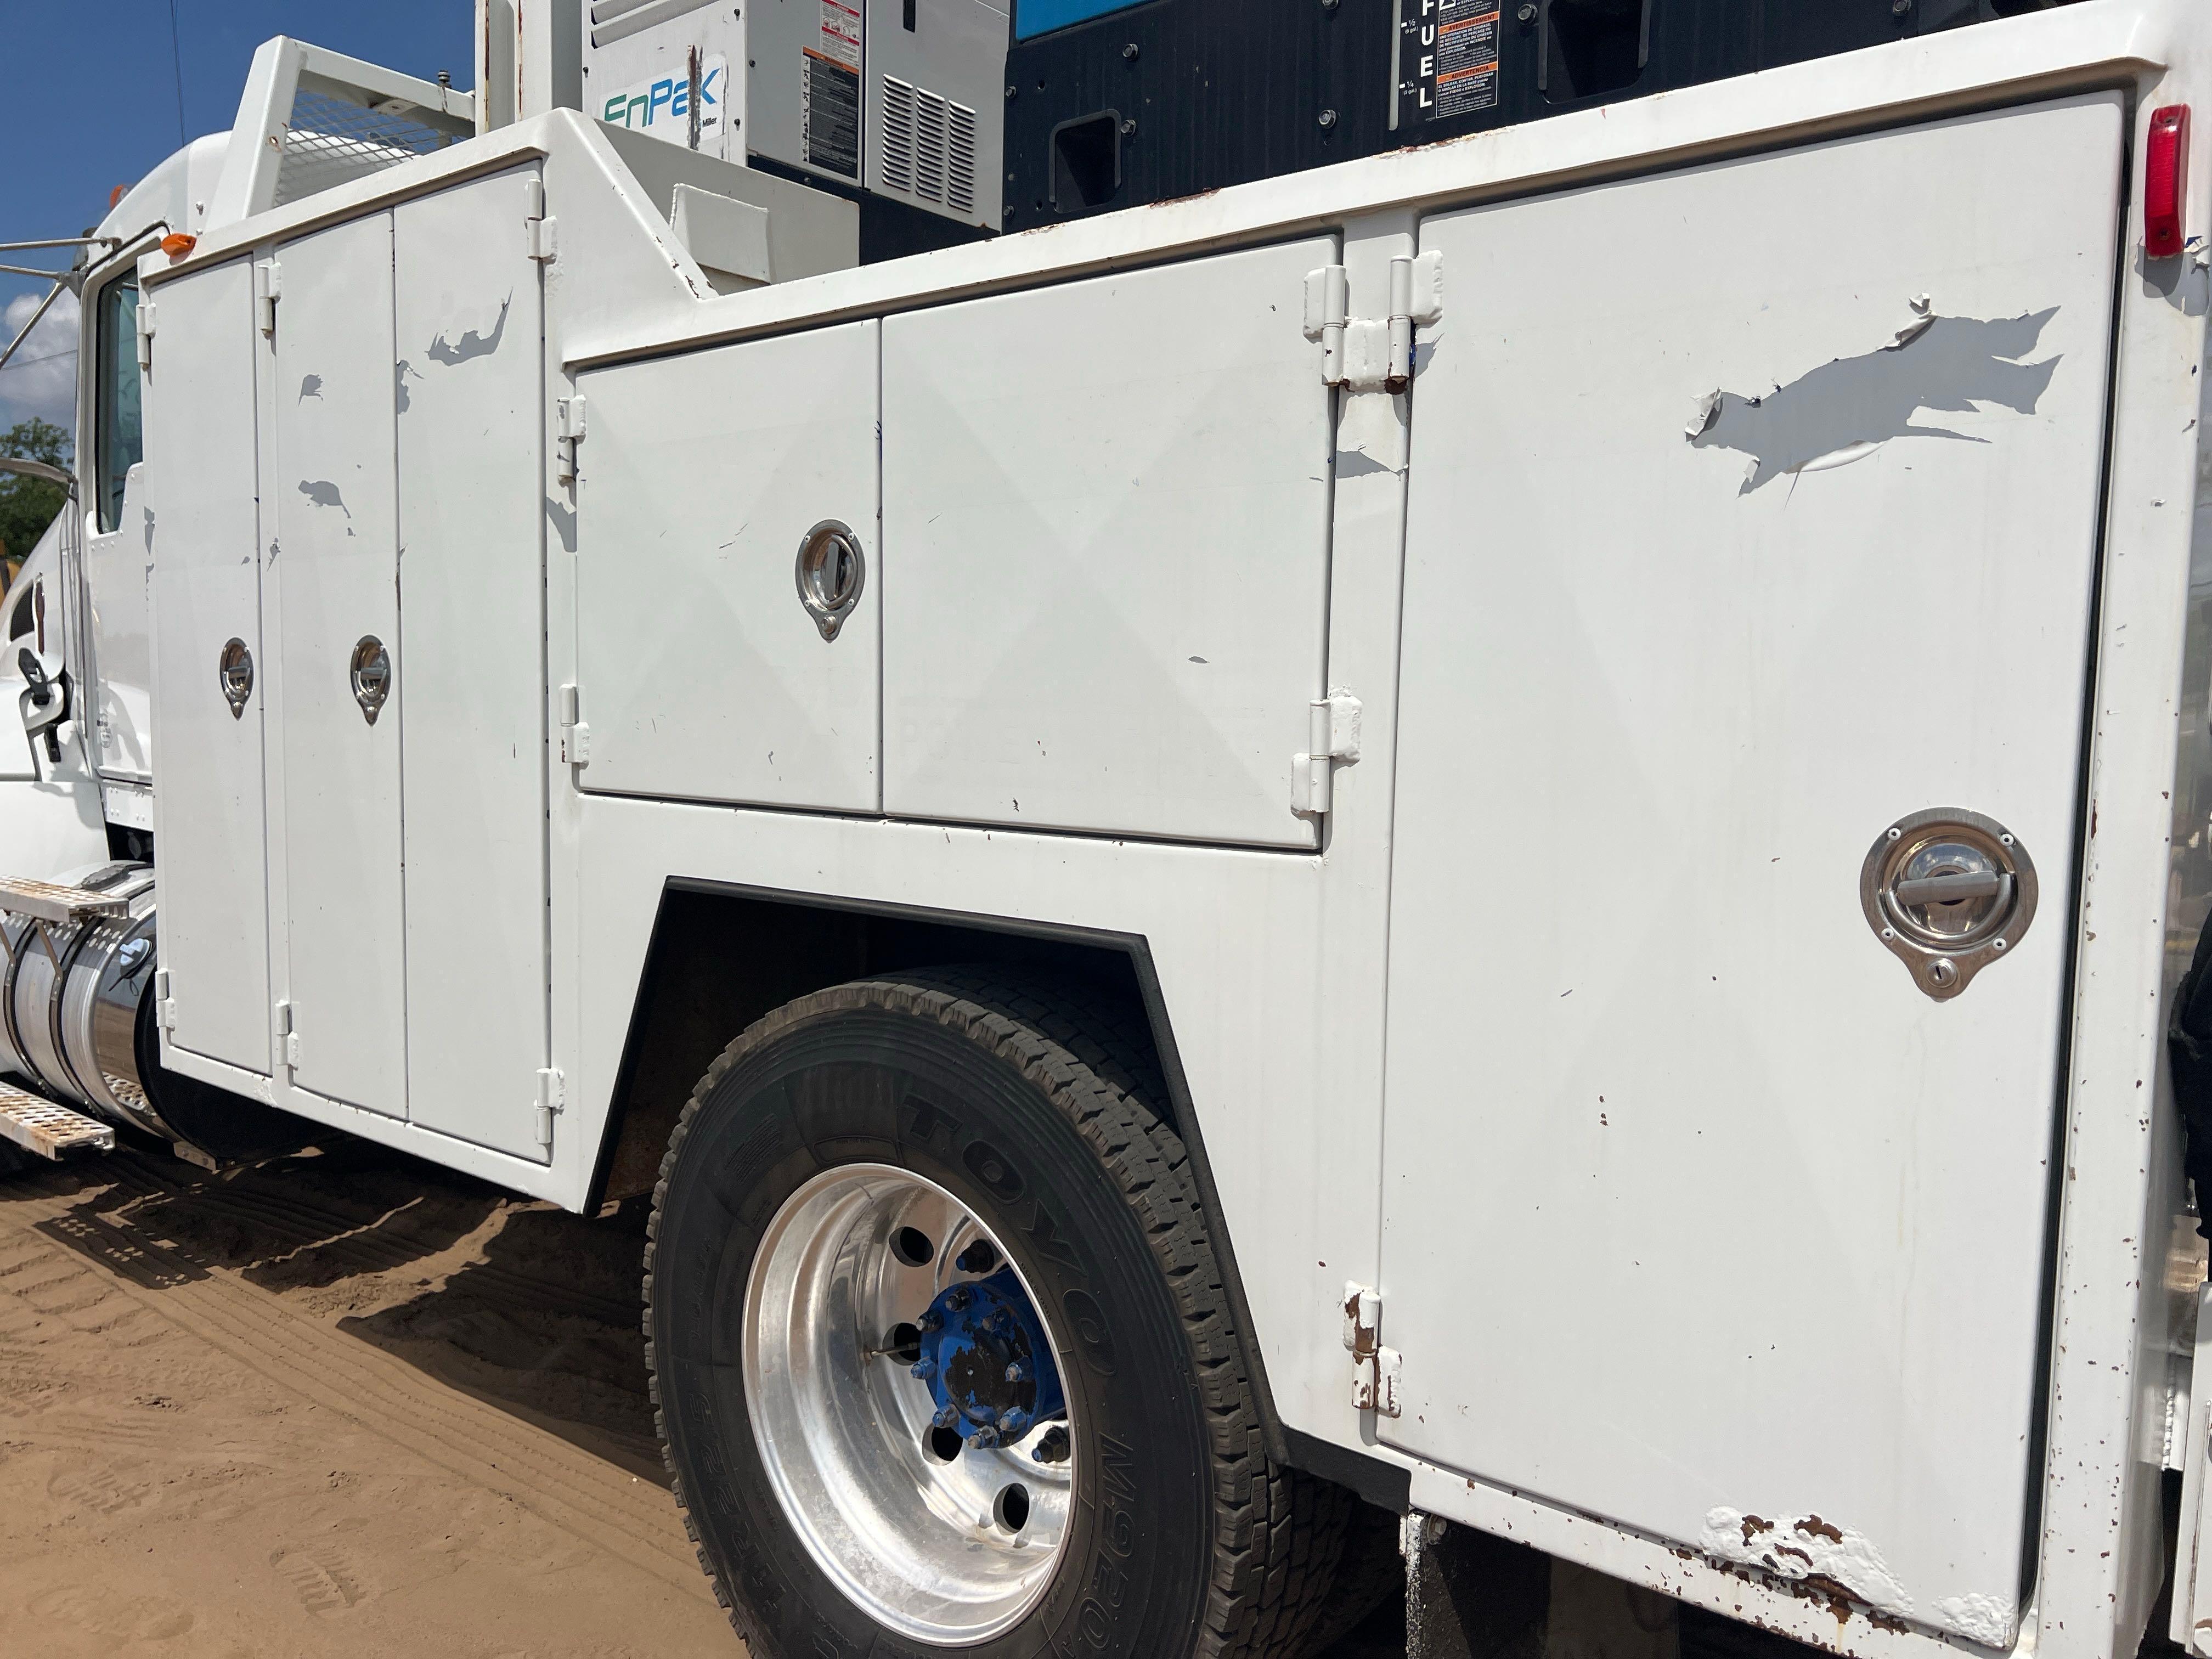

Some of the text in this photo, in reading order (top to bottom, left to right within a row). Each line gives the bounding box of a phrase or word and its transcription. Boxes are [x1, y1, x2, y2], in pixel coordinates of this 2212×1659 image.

[1448, 14, 1495, 31] AVERTISSEMENT
[1451, 65, 1489, 79] ADVERTENCIA
[702, 117, 717, 128] Miller
[899, 1092, 1118, 1376] TOYO
